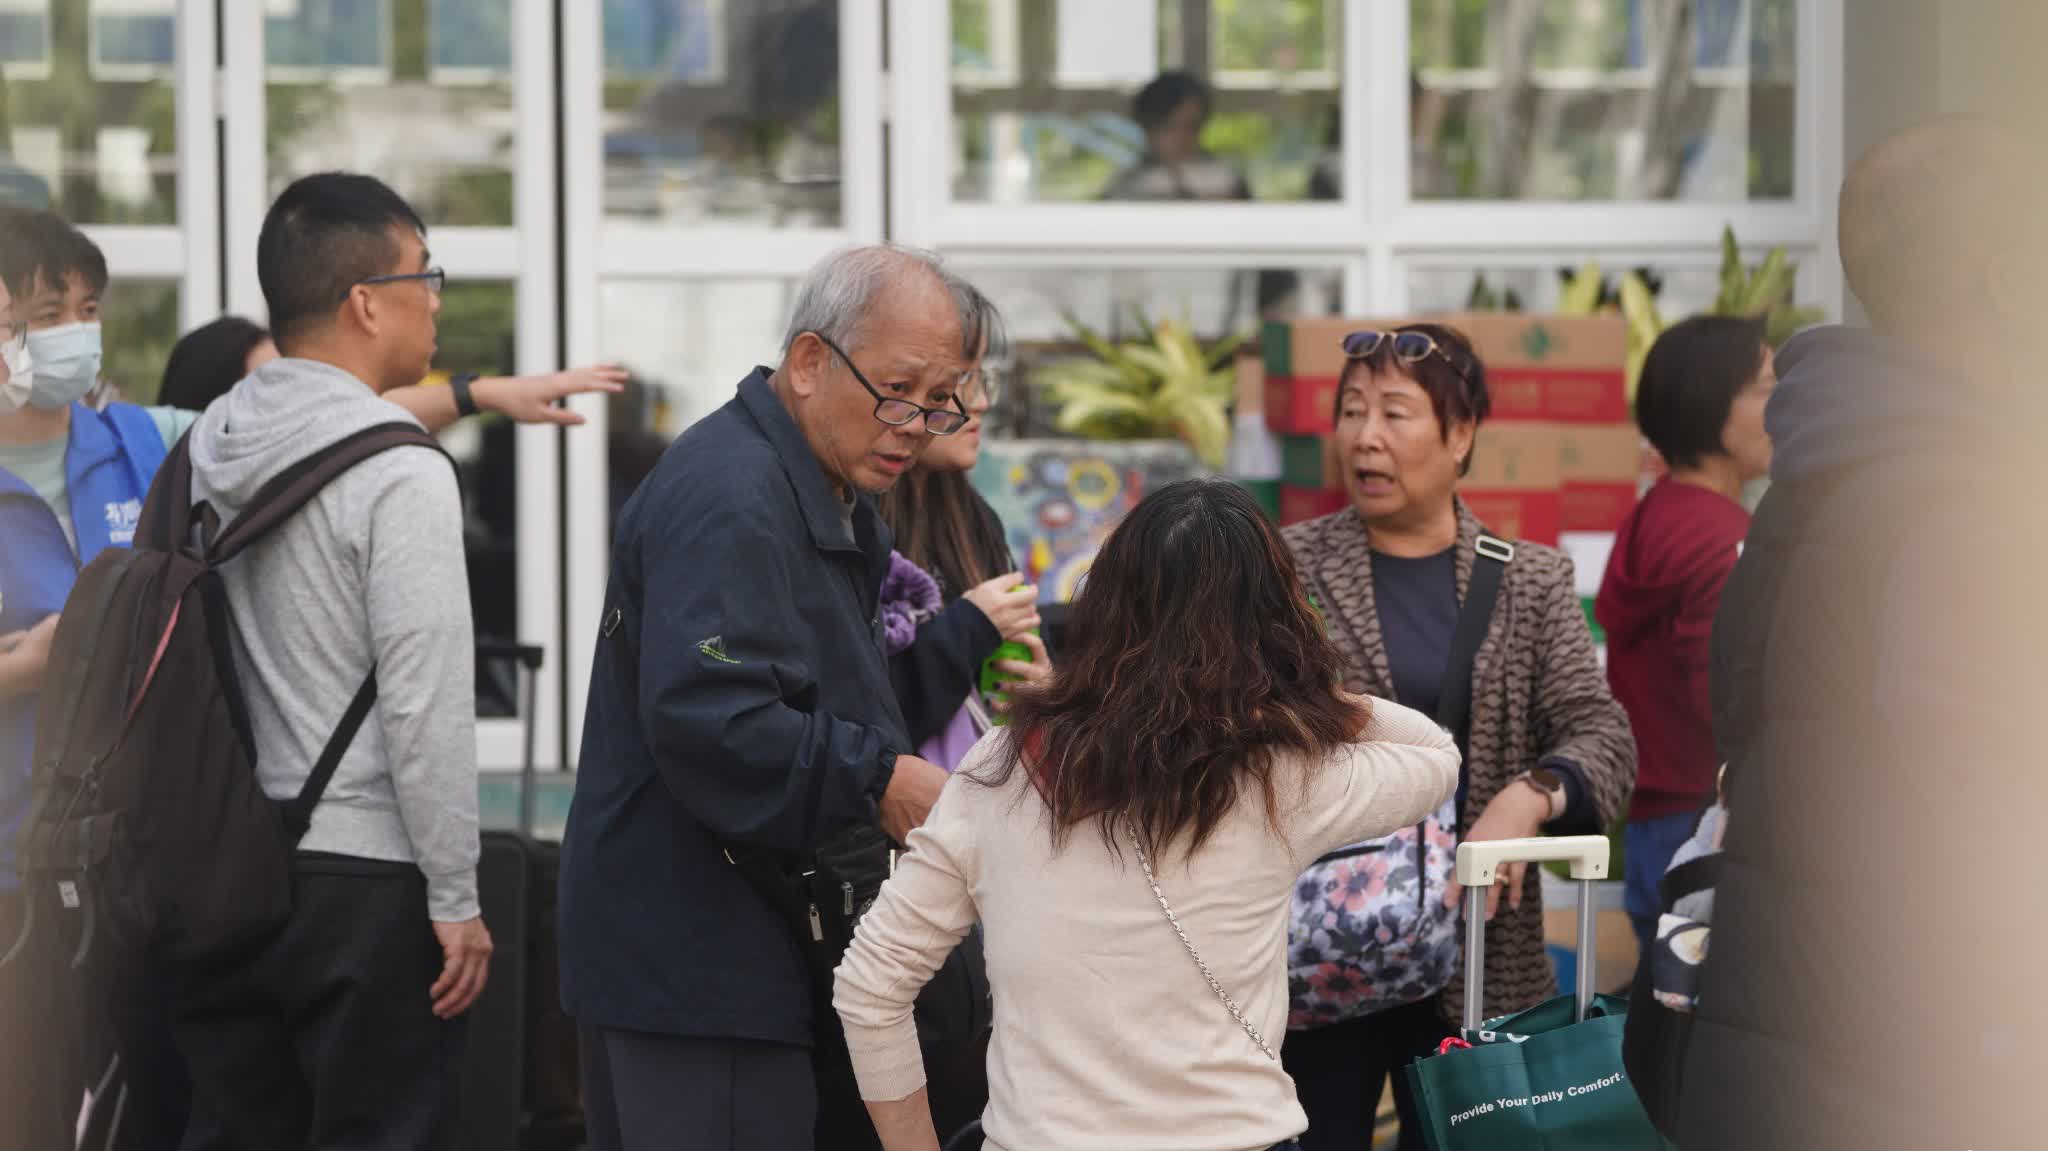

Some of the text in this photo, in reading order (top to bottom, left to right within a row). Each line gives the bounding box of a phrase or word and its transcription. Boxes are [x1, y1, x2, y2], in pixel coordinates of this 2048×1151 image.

[1450, 1102, 1494, 1126] Provide
[1496, 1098, 1528, 1109] Your
[1531, 1090, 1564, 1105] Daily
